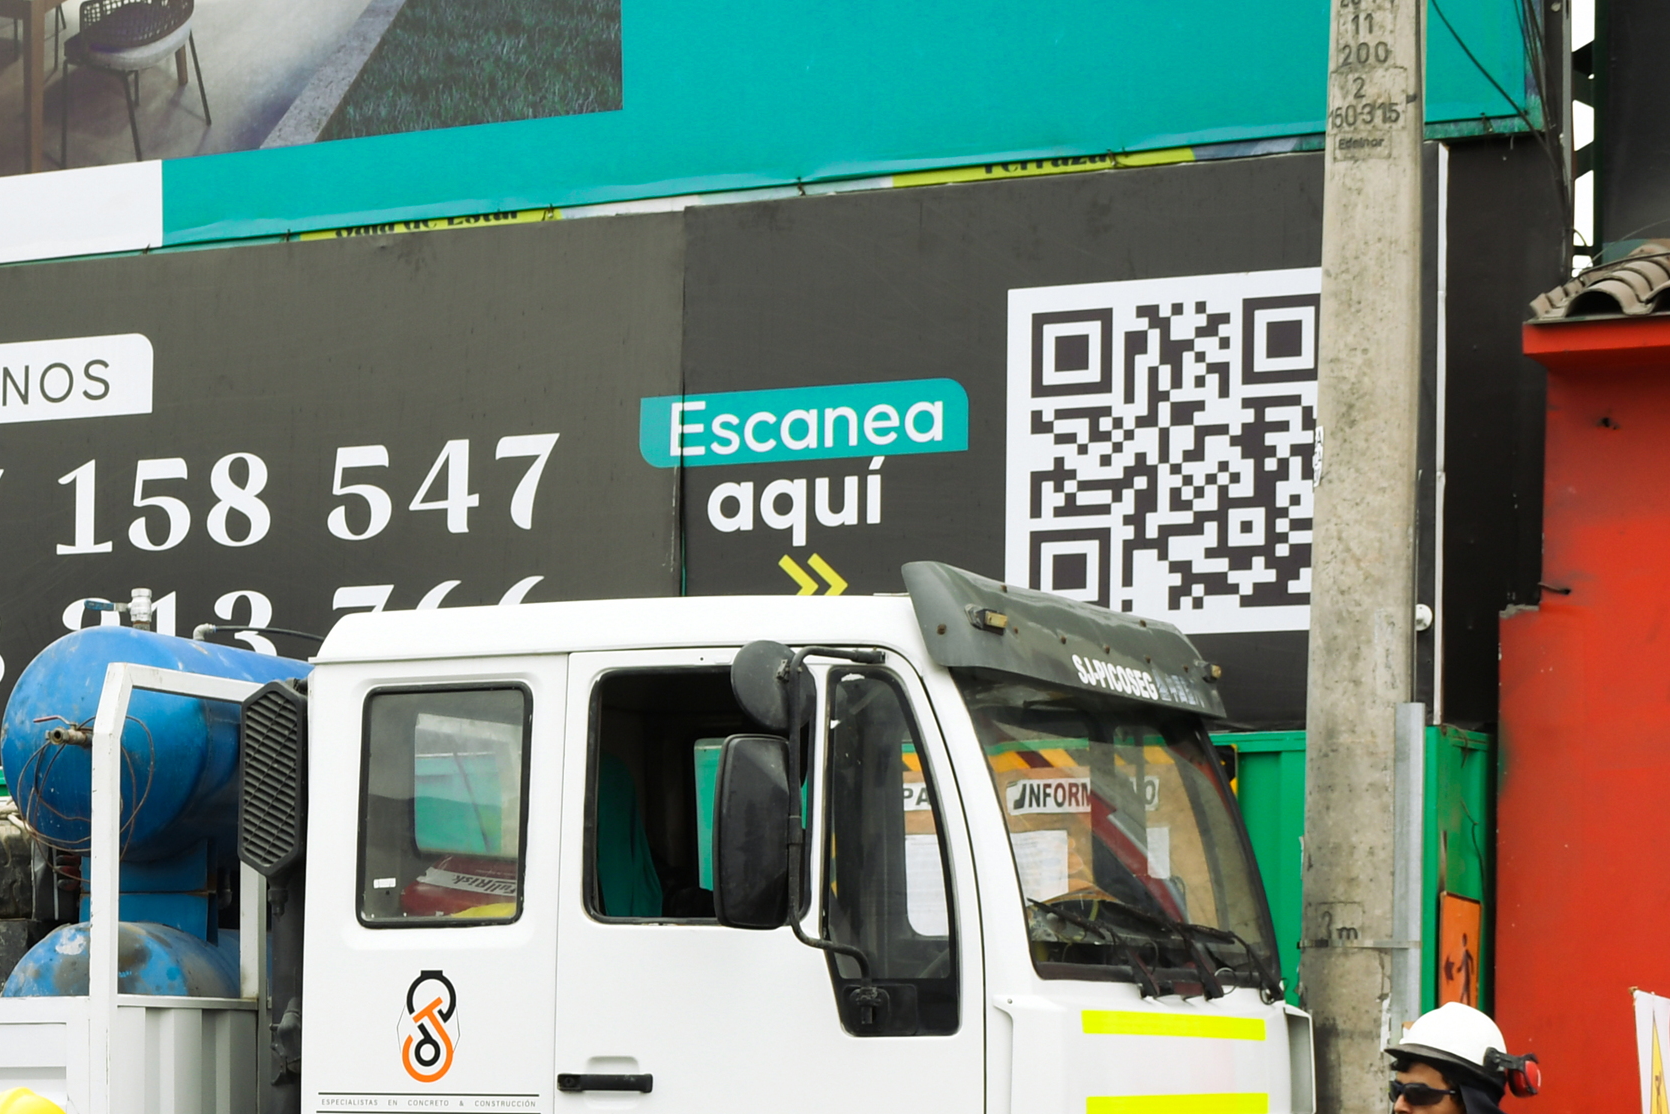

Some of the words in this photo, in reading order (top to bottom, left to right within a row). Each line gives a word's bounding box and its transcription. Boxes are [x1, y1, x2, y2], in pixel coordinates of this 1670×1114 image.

[1341, 41, 1390, 66] 200
[670, 400, 944, 457] Escanea
[56, 452, 271, 555] 158
[327, 433, 560, 541] 547
[707, 456, 885, 546] aquí
[1072, 654, 1159, 700] SJ-PICOSEG
[321, 1098, 378, 1107] ESPECIALISTAS
[387, 1098, 398, 1107] EN
[407, 1099, 450, 1108] CONCRETO
[474, 1098, 537, 1108] CONSTRUCCIÓN
